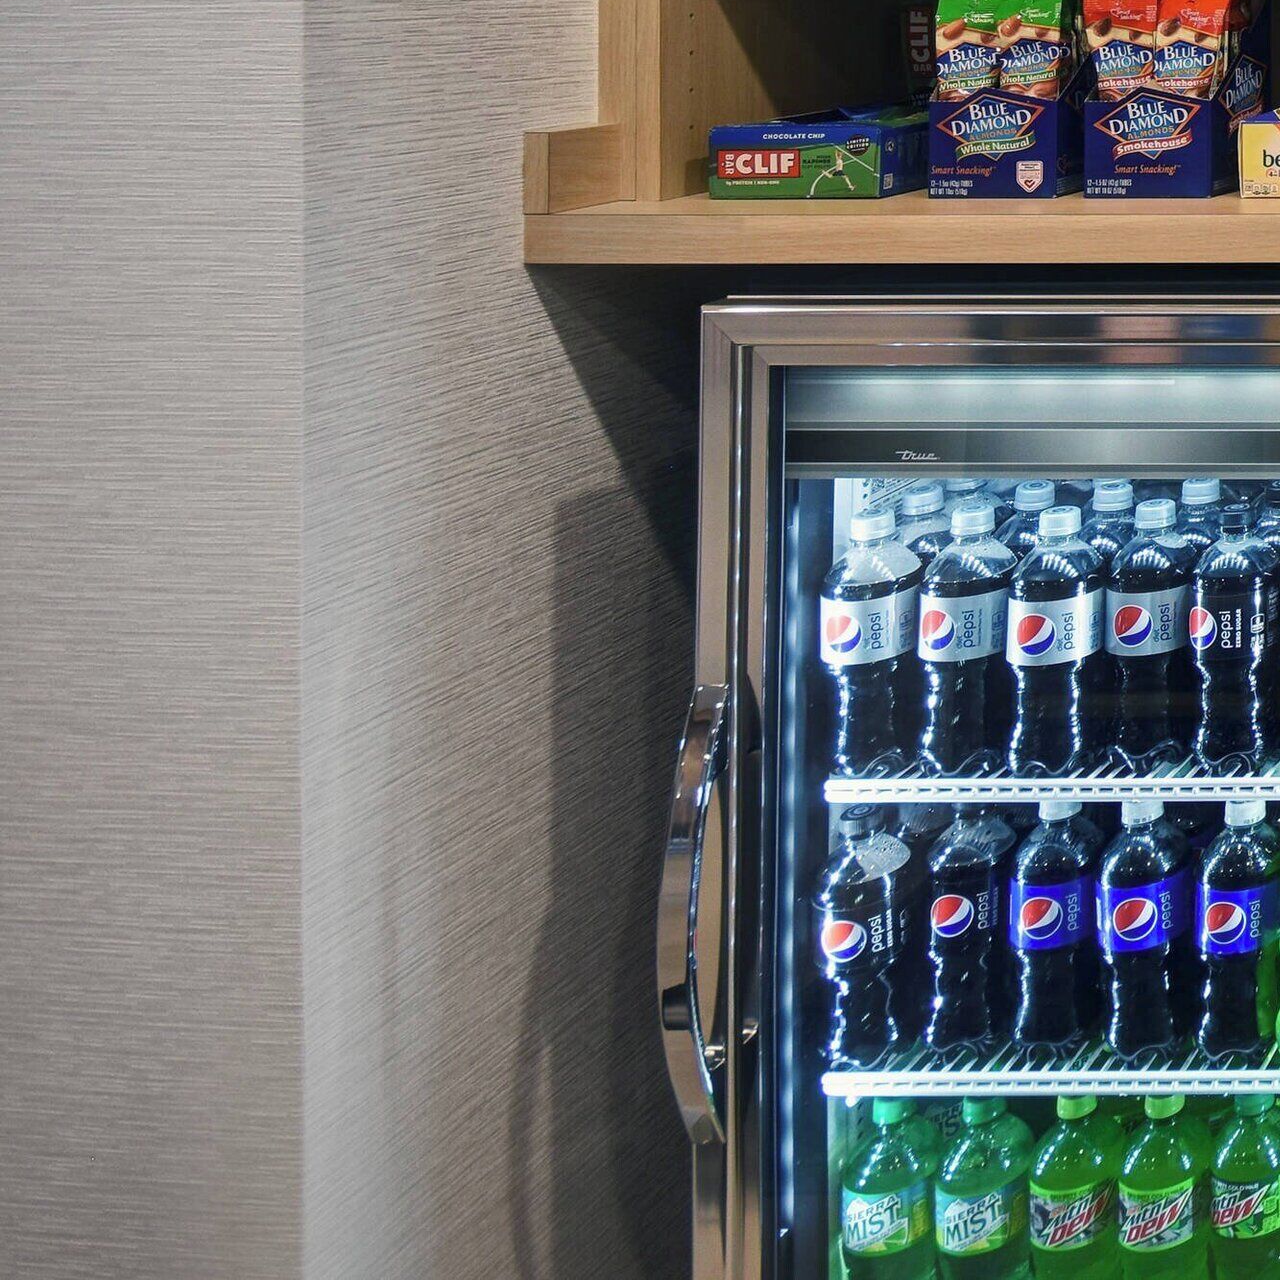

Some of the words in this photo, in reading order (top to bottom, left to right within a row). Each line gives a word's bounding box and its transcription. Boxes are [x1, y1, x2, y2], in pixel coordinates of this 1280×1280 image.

[909, 11, 931, 63] CLIF
[1011, 40, 1045, 58] BLUE
[950, 46, 987, 63] BLUE
[951, 109, 1032, 136] DIAMOND
[968, 102, 1012, 121] BLUE
[1109, 107, 1189, 135] DIAMOND
[960, 142, 991, 155] Whole
[992, 137, 1030, 151] Natural
[1116, 138, 1189, 155] Smokehouse
[725, 154, 735, 175] BAR
[736, 153, 795, 175] CLIF
[930, 166, 955, 175] Smart
[1114, 164, 1139, 174] Smart
[867, 611, 882, 650] pepsi
[962, 609, 977, 649] pepsi
[1062, 611, 1077, 651] pepsi
[1159, 602, 1173, 641] pepsi
[850, 1207, 901, 1245] MIST
[946, 1207, 1002, 1246] MIST
